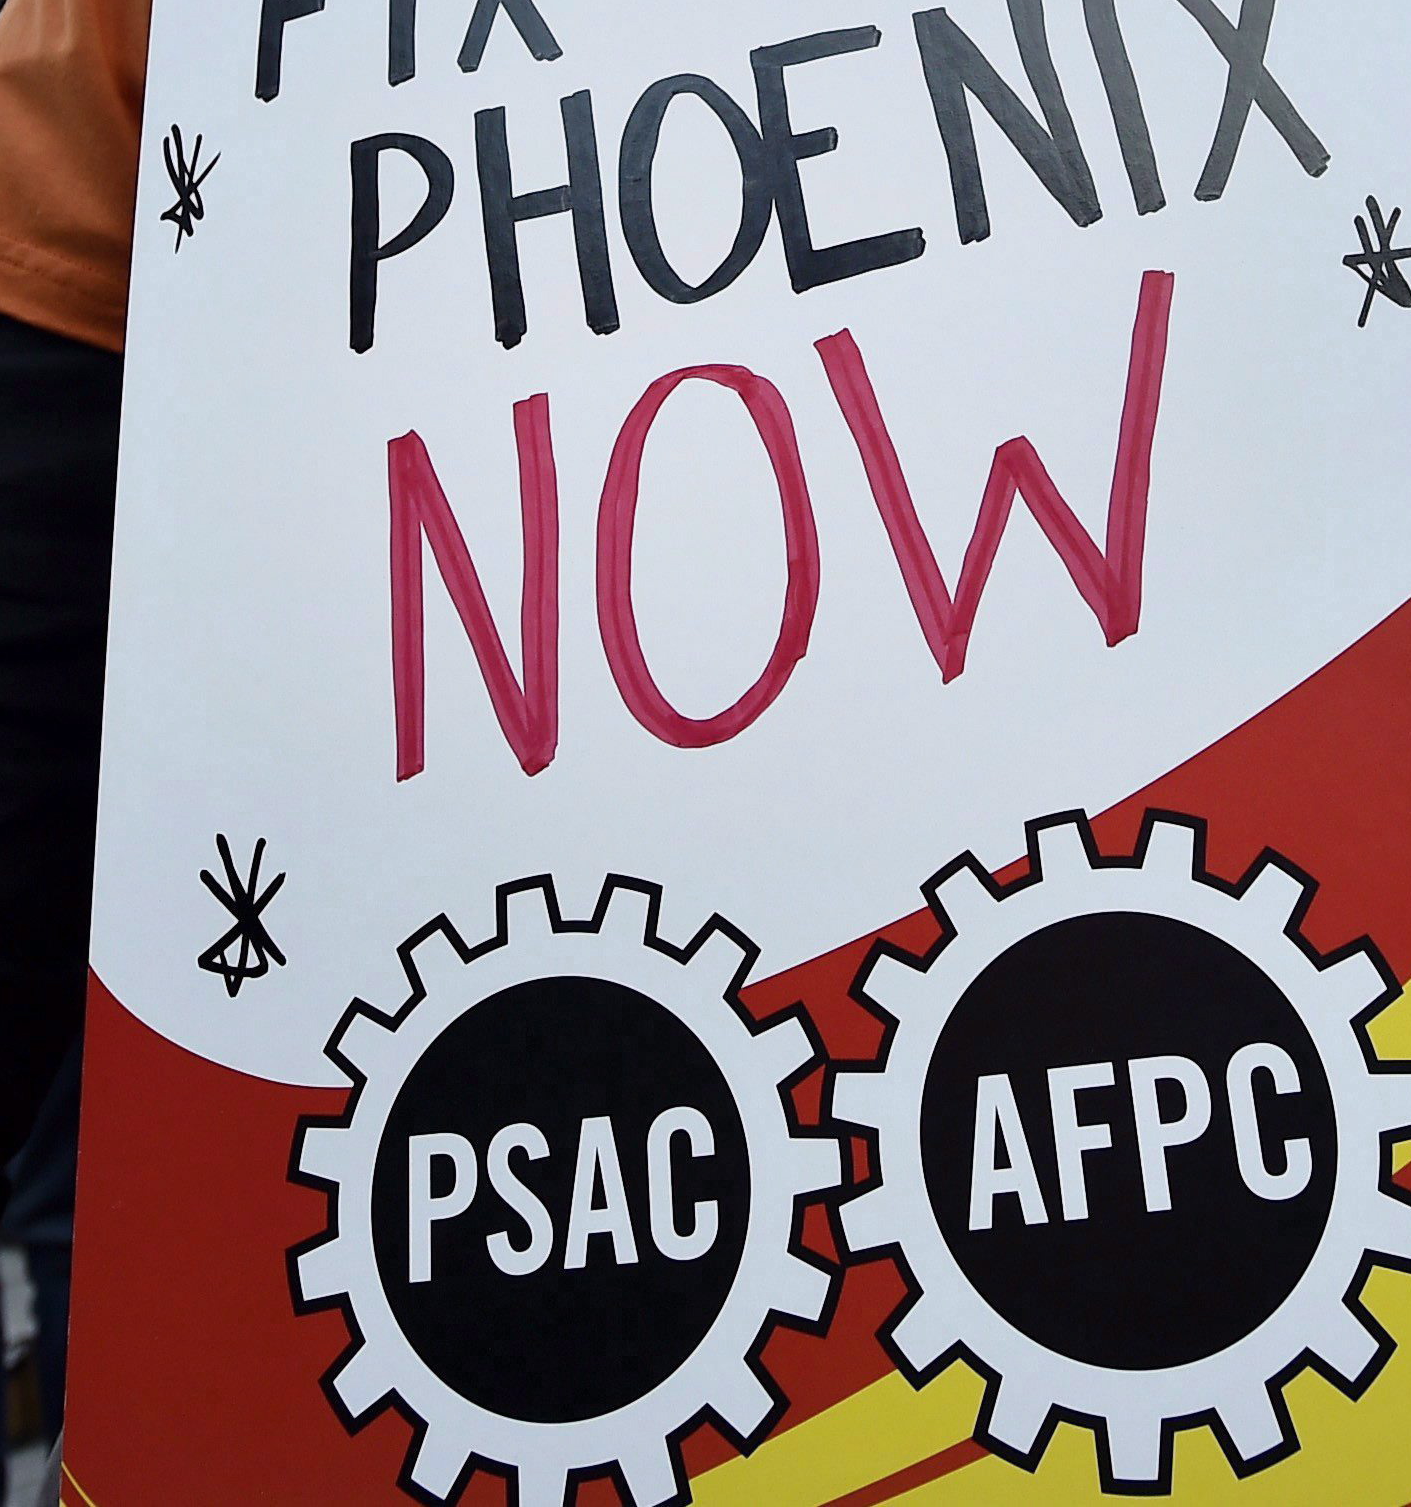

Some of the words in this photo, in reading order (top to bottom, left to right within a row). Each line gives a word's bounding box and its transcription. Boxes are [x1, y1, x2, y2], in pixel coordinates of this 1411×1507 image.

[387, 270, 1175, 782] NOW
[408, 1104, 721, 1283] PSAC
[968, 1041, 1314, 1233] AFPC
